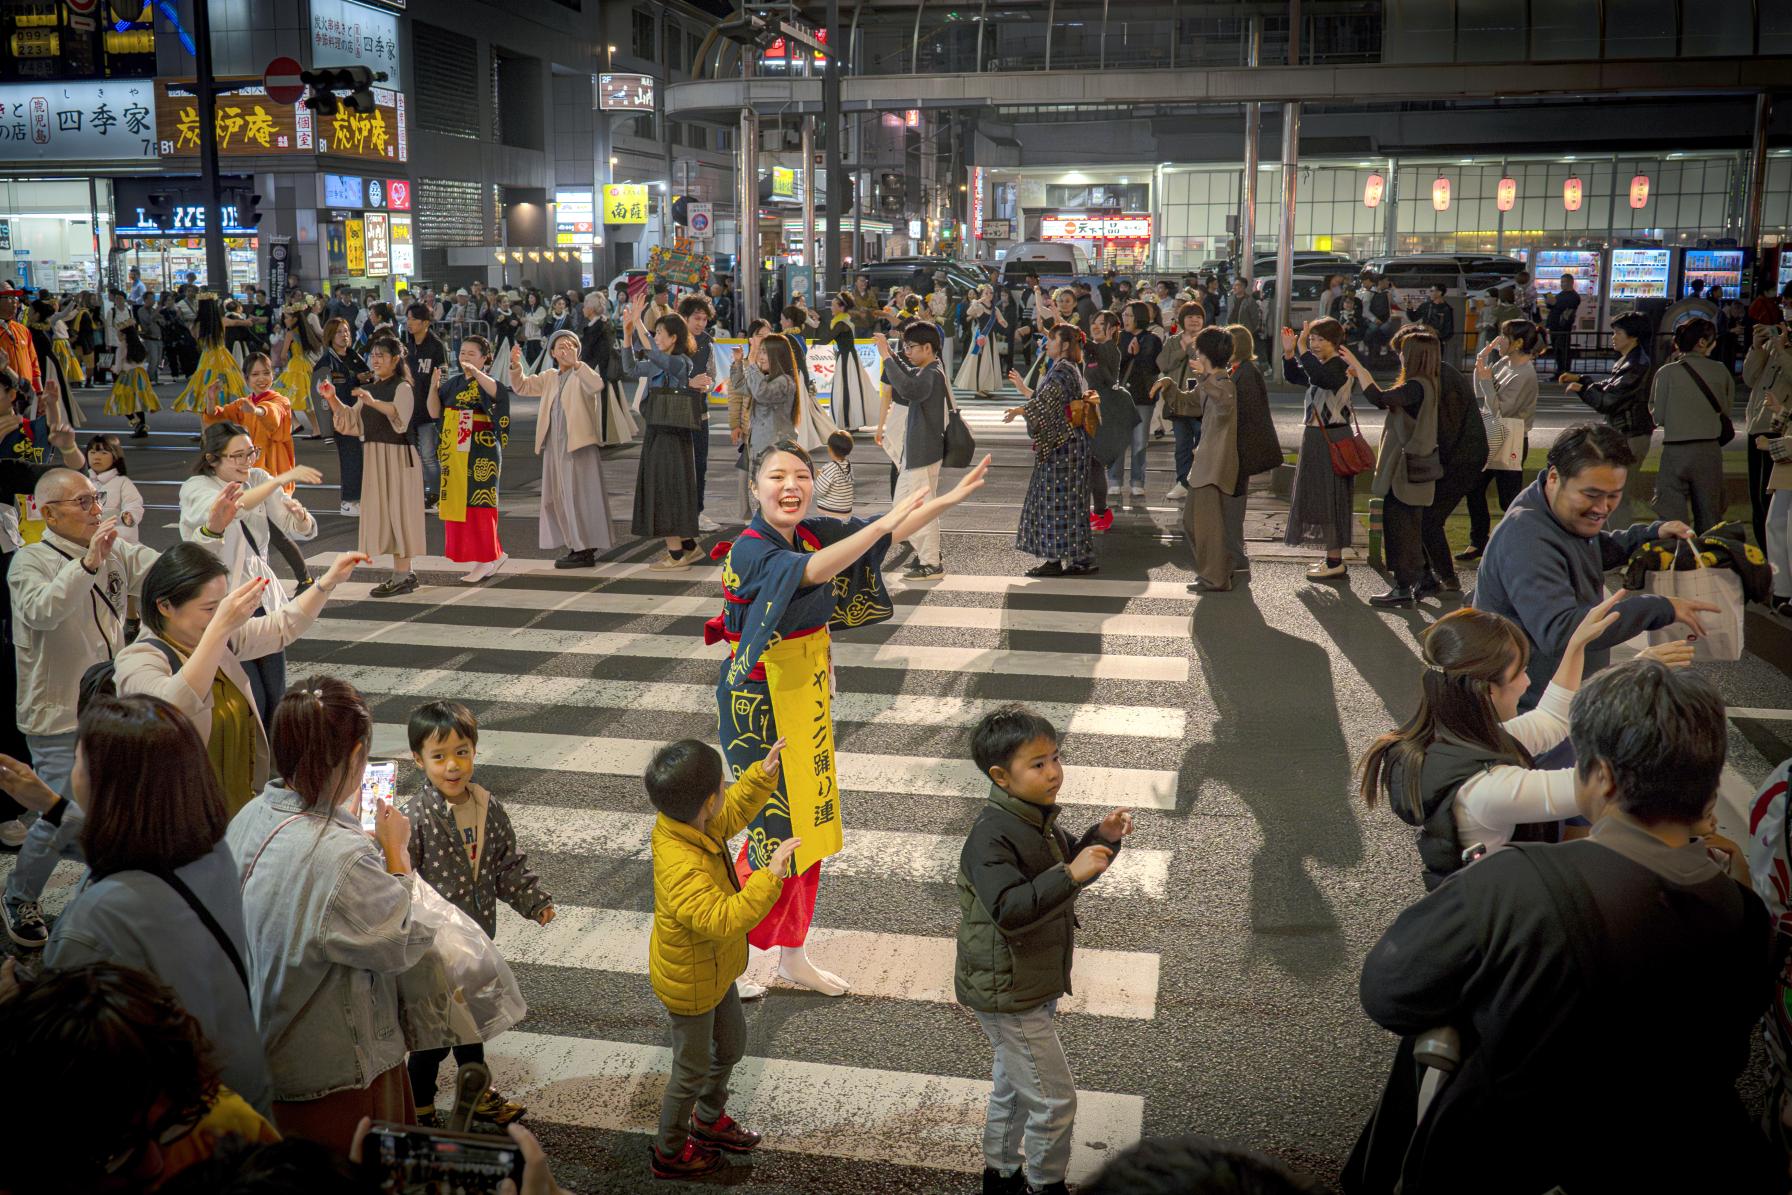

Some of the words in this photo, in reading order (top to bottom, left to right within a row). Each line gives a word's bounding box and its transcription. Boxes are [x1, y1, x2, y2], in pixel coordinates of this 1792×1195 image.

[363, 36, 396, 61] 四季家
[56, 102, 151, 136] 四季家
[160, 141, 174, 154] B1
[319, 138, 327, 152] B1
